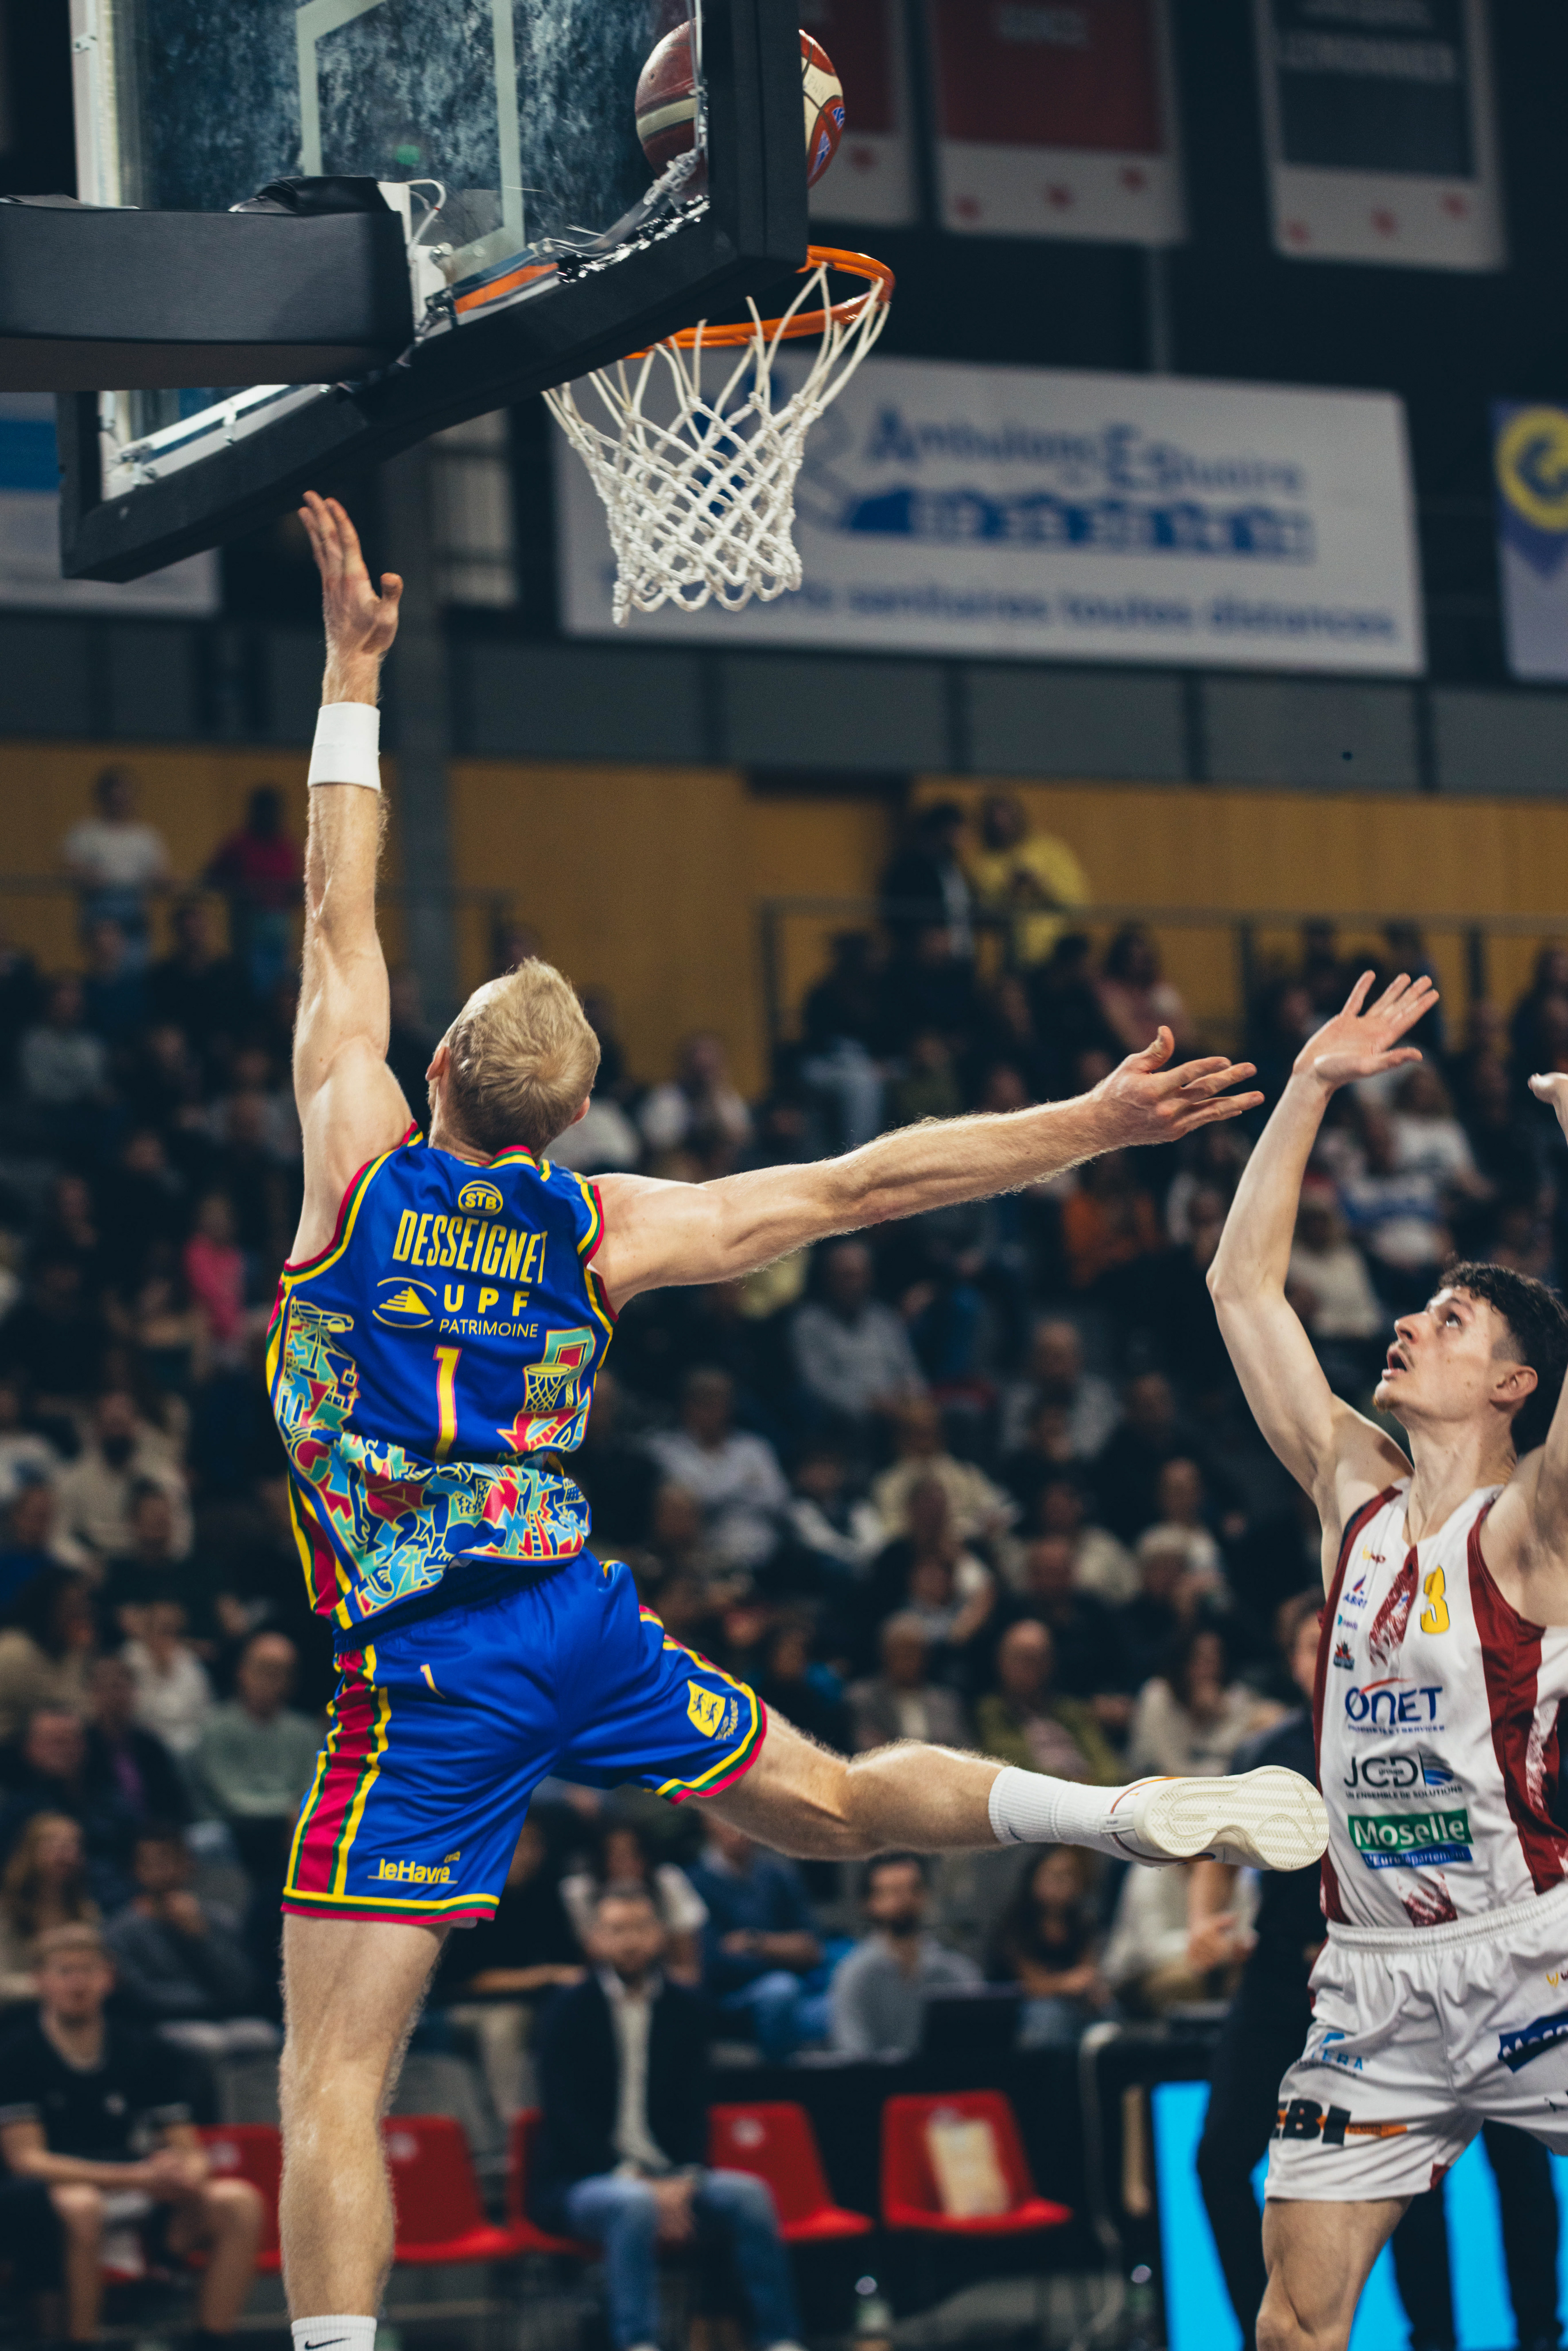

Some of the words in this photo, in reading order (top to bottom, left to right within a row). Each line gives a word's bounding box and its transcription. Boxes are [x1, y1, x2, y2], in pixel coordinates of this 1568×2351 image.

[465, 1192, 497, 1210] STB
[392, 1209, 548, 1284] DESSEIGNET
[439, 1319, 539, 1338] PATRIMOINE
[433, 1344, 463, 1465] 1
[1420, 1564, 1450, 1635] 3
[420, 1663, 447, 1699] 1
[1413, 1784, 1463, 1799] SOLUTIONS
[1354, 1814, 1465, 1847] Moselle
